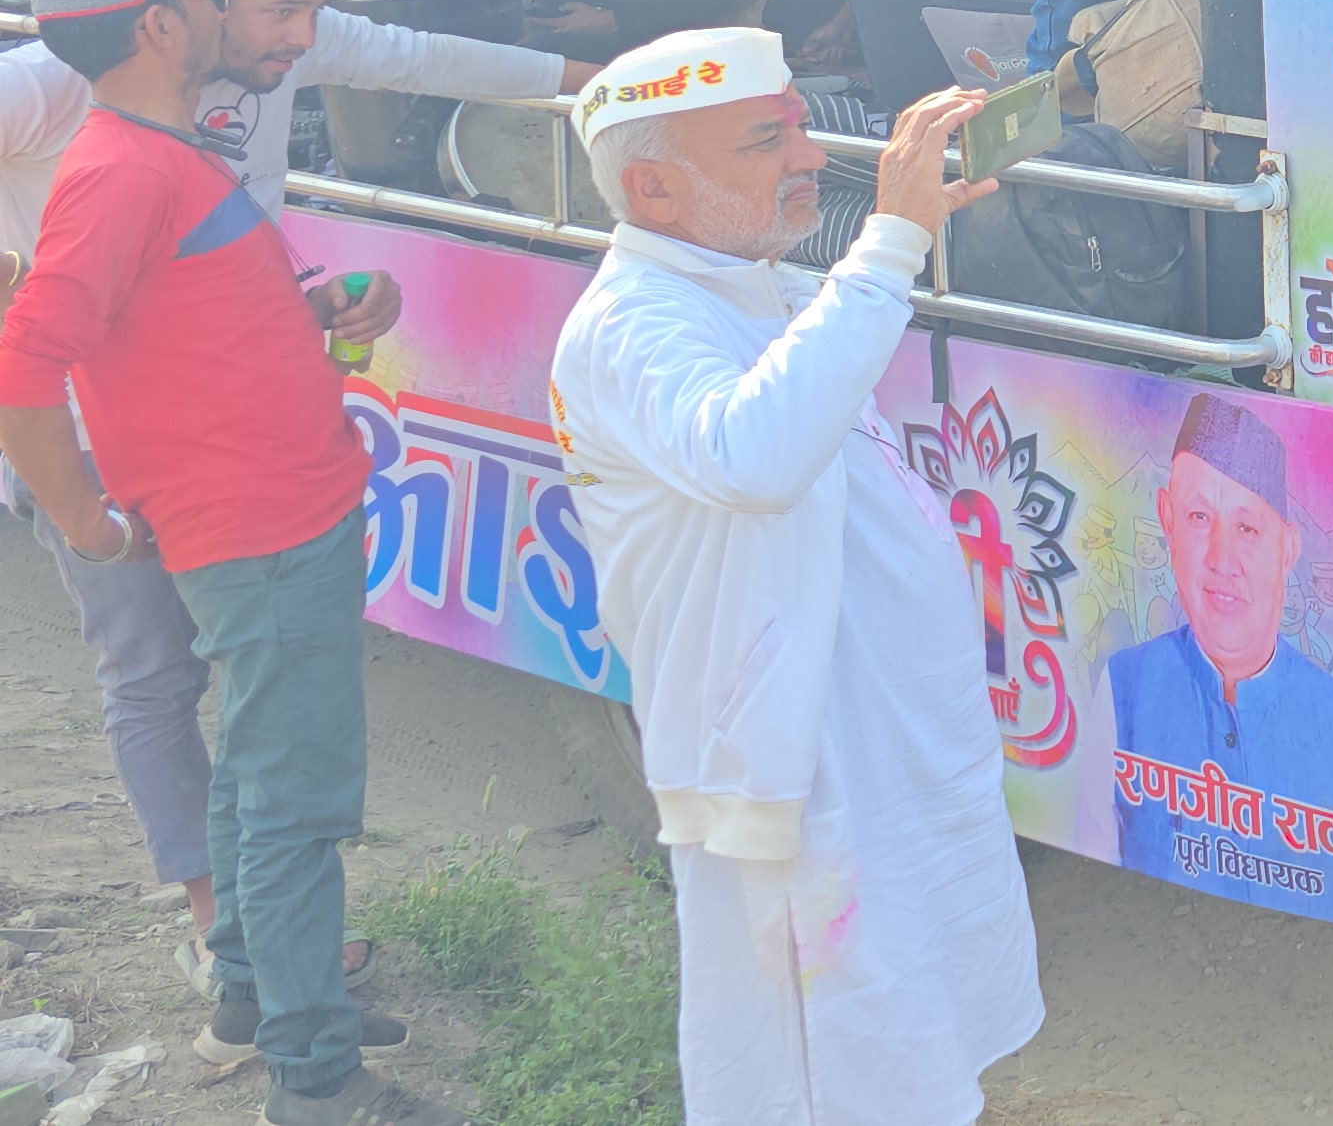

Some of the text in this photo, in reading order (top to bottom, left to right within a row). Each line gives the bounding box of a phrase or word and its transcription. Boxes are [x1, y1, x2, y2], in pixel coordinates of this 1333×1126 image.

[616, 64, 690, 103] आई
[697, 60, 727, 86] रे
[1308, 344, 1323, 365] की
[1112, 759, 1265, 841] रणजीत
[1174, 832, 1325, 897] पूर्व विधायक
